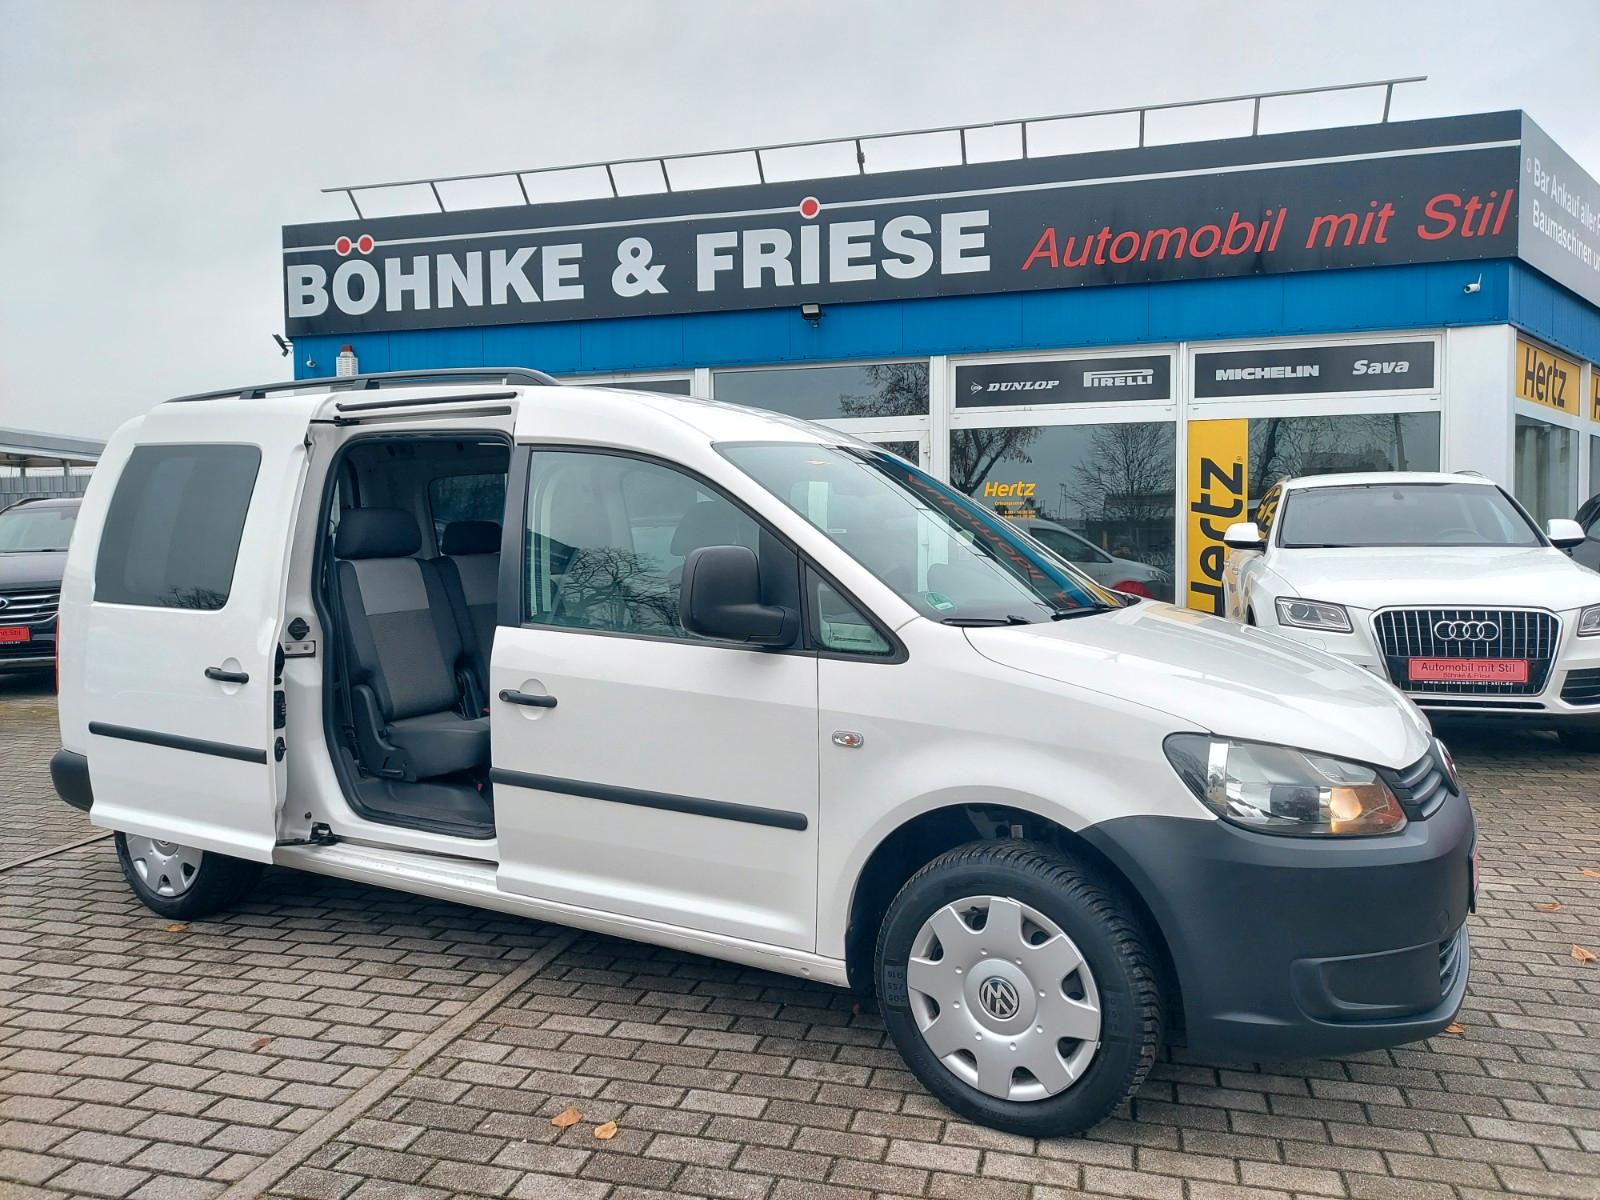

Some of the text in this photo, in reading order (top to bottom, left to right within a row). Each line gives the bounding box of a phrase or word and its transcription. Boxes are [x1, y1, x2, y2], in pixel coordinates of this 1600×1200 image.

[1534, 157, 1550, 195] Bar
[1551, 174, 1580, 219] Ankauf
[1021, 188, 1514, 270] Automobil mit Stil
[1532, 199, 1592, 266] Baumaschinen
[287, 196, 991, 319] BÖHNKE & FRIESE
[1215, 364, 1320, 381] MICHELIN
[1352, 359, 1410, 376] Sava
[1523, 346, 1567, 408] Hertz
[986, 380, 1060, 393] DUNLOP
[1083, 368, 1154, 388] PIRELLI
[983, 480, 1036, 497] Hertz
[1421, 662, 1515, 673] Automobil mit Stil
